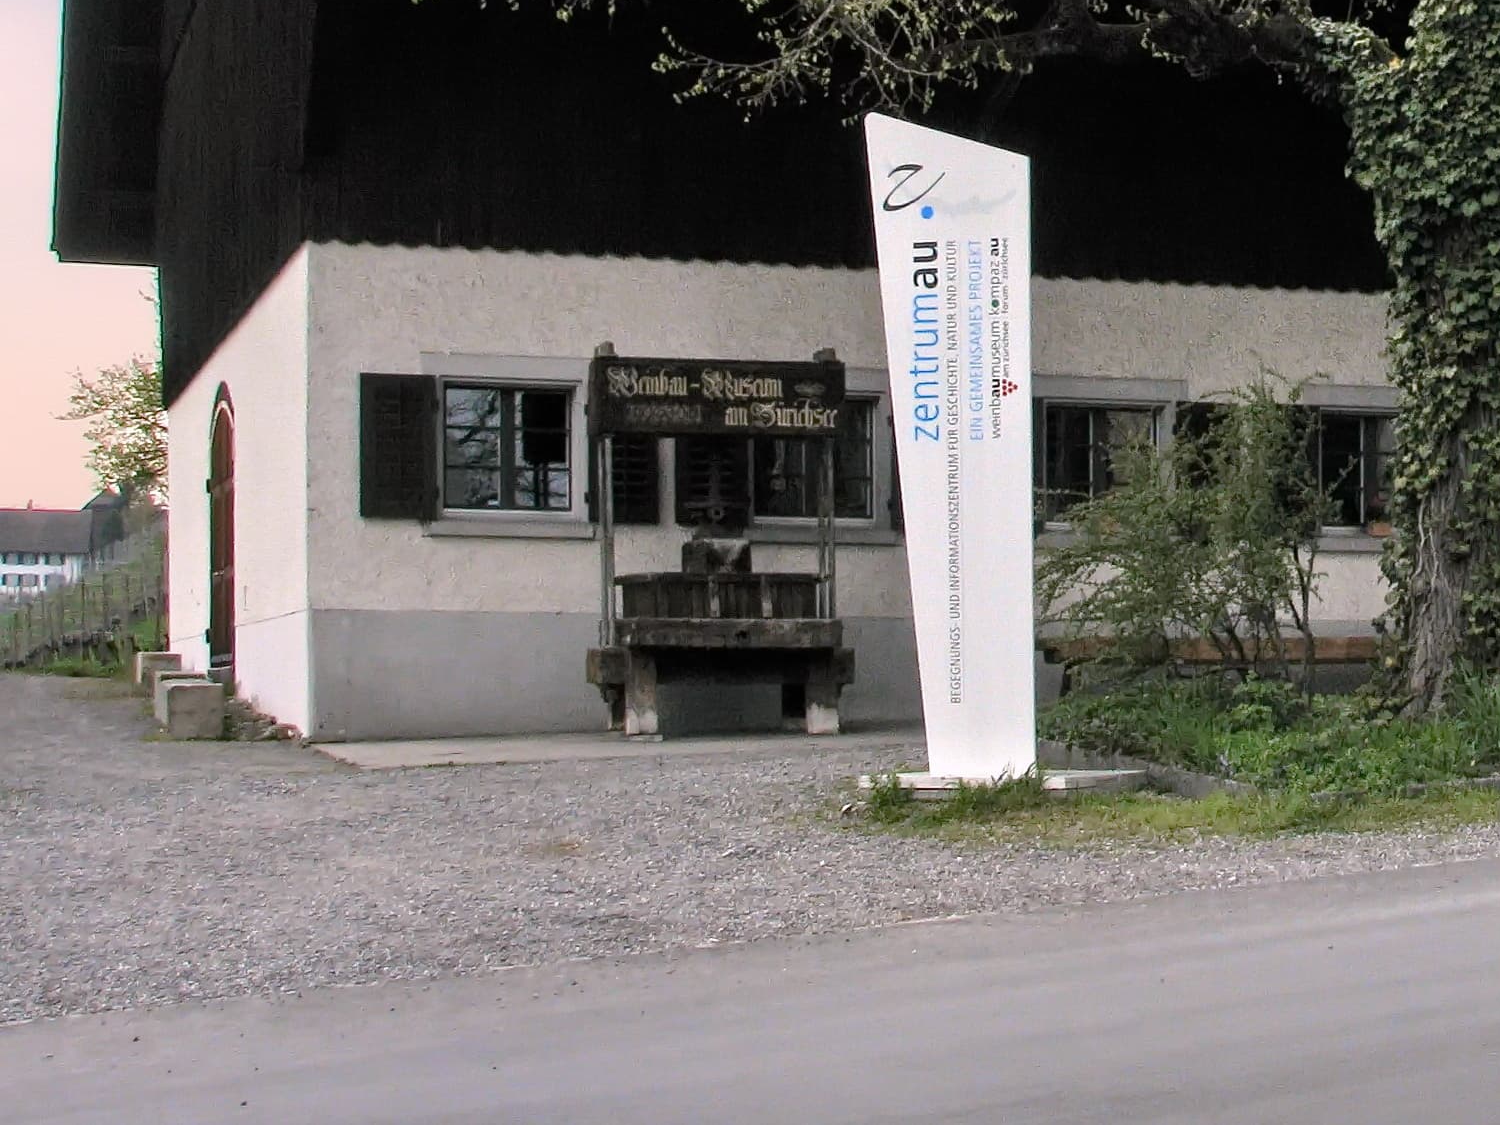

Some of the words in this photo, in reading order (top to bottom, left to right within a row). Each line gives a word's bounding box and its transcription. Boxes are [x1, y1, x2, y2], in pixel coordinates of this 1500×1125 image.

[945, 240, 957, 281] KULTUR
[967, 241, 983, 300] PROJEKT
[946, 286, 957, 309] UND
[908, 240, 940, 442] zentrumau
[946, 313, 958, 350] NATUR
[968, 305, 983, 412] GEMEINSAMES
[989, 321, 1001, 439] weinbaumuseum
[969, 418, 984, 441] EIN
[947, 454, 960, 591] INFORMATIONSZENTRUM
[949, 594, 961, 619] UND
